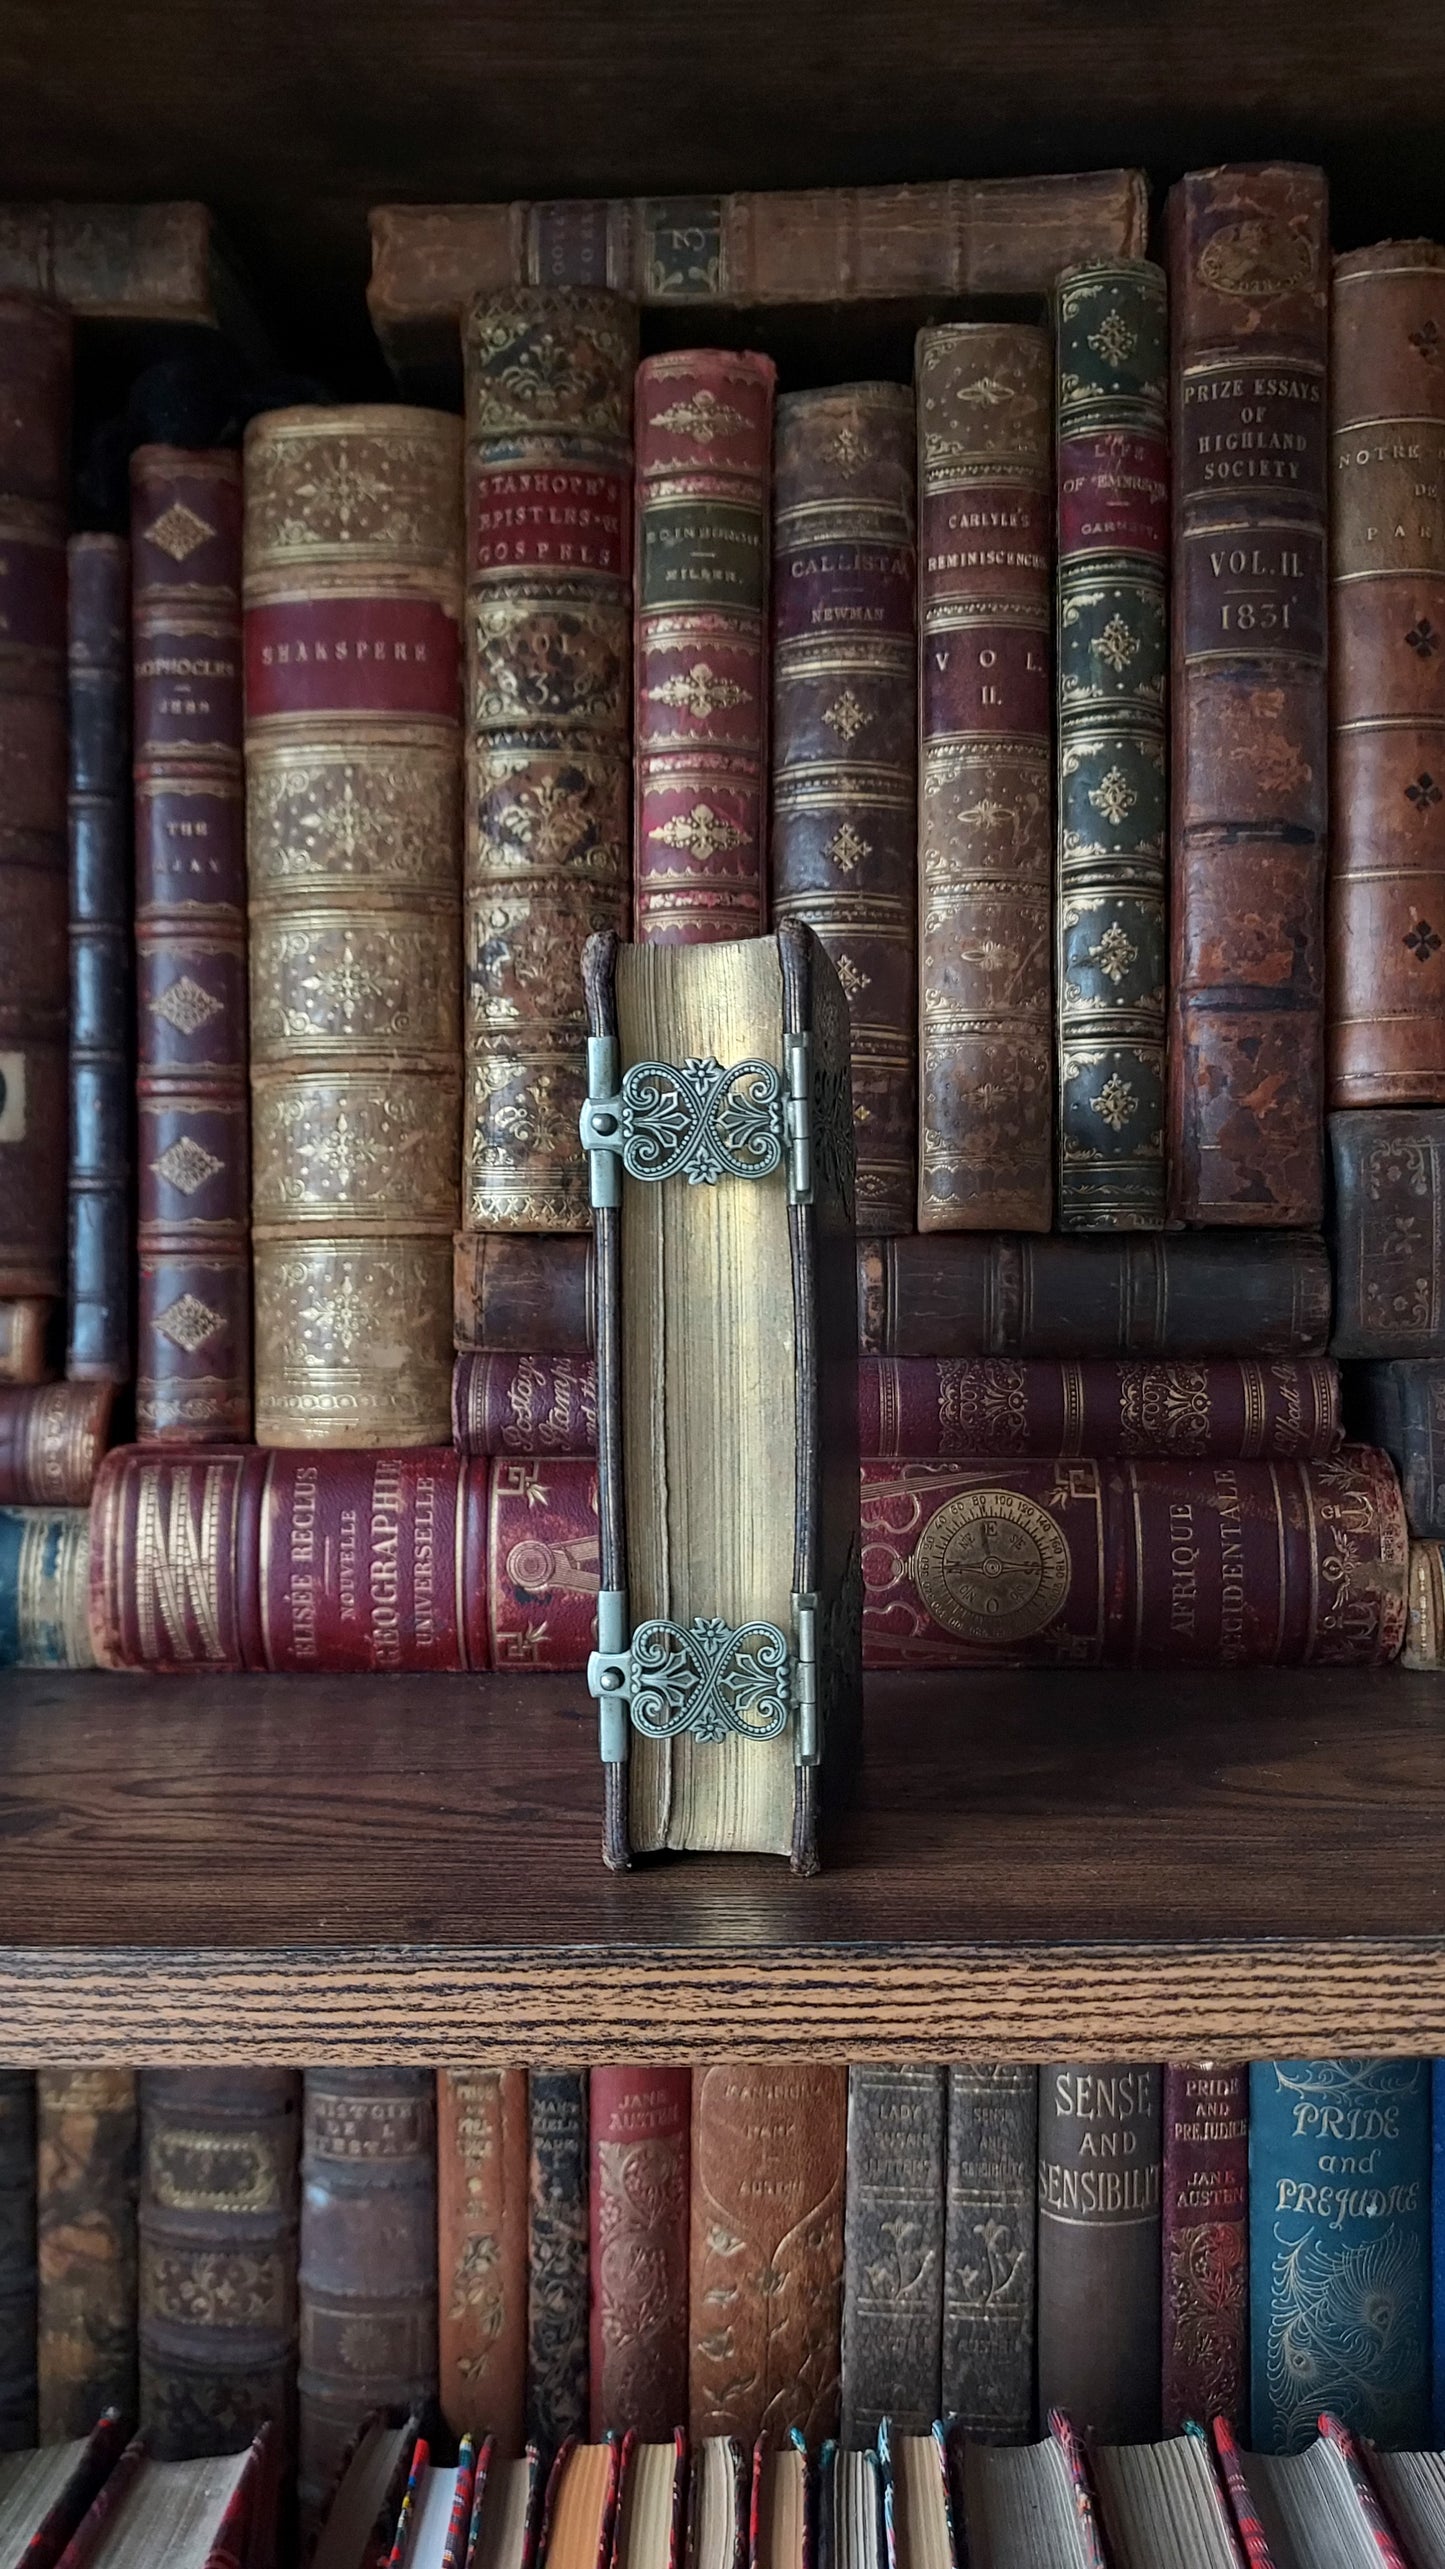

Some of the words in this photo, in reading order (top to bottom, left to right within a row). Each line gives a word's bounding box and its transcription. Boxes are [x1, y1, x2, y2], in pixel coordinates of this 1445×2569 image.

[1184, 379, 1243, 404] PRIZE
[1254, 378, 1320, 401] ESSAYS
[1240, 406, 1267, 424] OF
[1095, 444, 1144, 461] LIFE
[1198, 432, 1307, 454] HIGHLAND
[1339, 444, 1420, 469] NOTRE
[1204, 460, 1299, 480] SOCIETY
[478, 475, 617, 500] STANHOPE'S
[1063, 477, 1085, 493] OF
[1415, 484, 1437, 498] DE
[949, 508, 1030, 529] CARLYLE'S
[1368, 525, 1443, 541] PAR
[479, 542, 610, 566] GOSPELS
[791, 554, 907, 578] CALLISTA
[811, 606, 885, 623] NEWMAN
[1220, 603, 1290, 630] 1831
[262, 640, 427, 665] SHAKSPERE
[167, 821, 208, 836] THE
[950, 1502, 965, 1516] 60
[972, 1495, 987, 1506] 80
[995, 1495, 1014, 1508] 100
[1018, 1501, 1035, 1517] 120
[290, 1467, 318, 1563] RECLUS
[935, 1515, 947, 1530] 40
[1037, 1515, 1051, 1533] 140
[924, 1536, 935, 1551] 20
[1050, 1536, 1063, 1555] 160
[340, 1510, 357, 1621] NOUVELLE
[364, 1459, 402, 1664] GÉOGRAPHIE
[413, 1476, 435, 1648] UNIVERSELLE
[920, 1557, 930, 1577] 360
[1056, 1560, 1065, 1579] 180
[1169, 1503, 1200, 1638] AFRIQUE
[1055, 2071, 1151, 2121] SENSE
[1186, 2078, 1240, 2096] PRIDE
[618, 2089, 666, 2110] JANE
[1196, 2102, 1230, 2117] AND
[609, 2103, 679, 2131] AUSTEN
[880, 2104, 921, 2120] LADY
[1291, 2101, 1400, 2141] PRIDE
[1174, 2119, 1248, 2141] PREJUDICE
[1079, 2131, 1137, 2157] AND
[1318, 2148, 1381, 2174] and
[1187, 2170, 1236, 2187] JANE
[1177, 2187, 1244, 2208] AUSTEN
[1275, 2177, 1420, 2231] PREJUDICE
